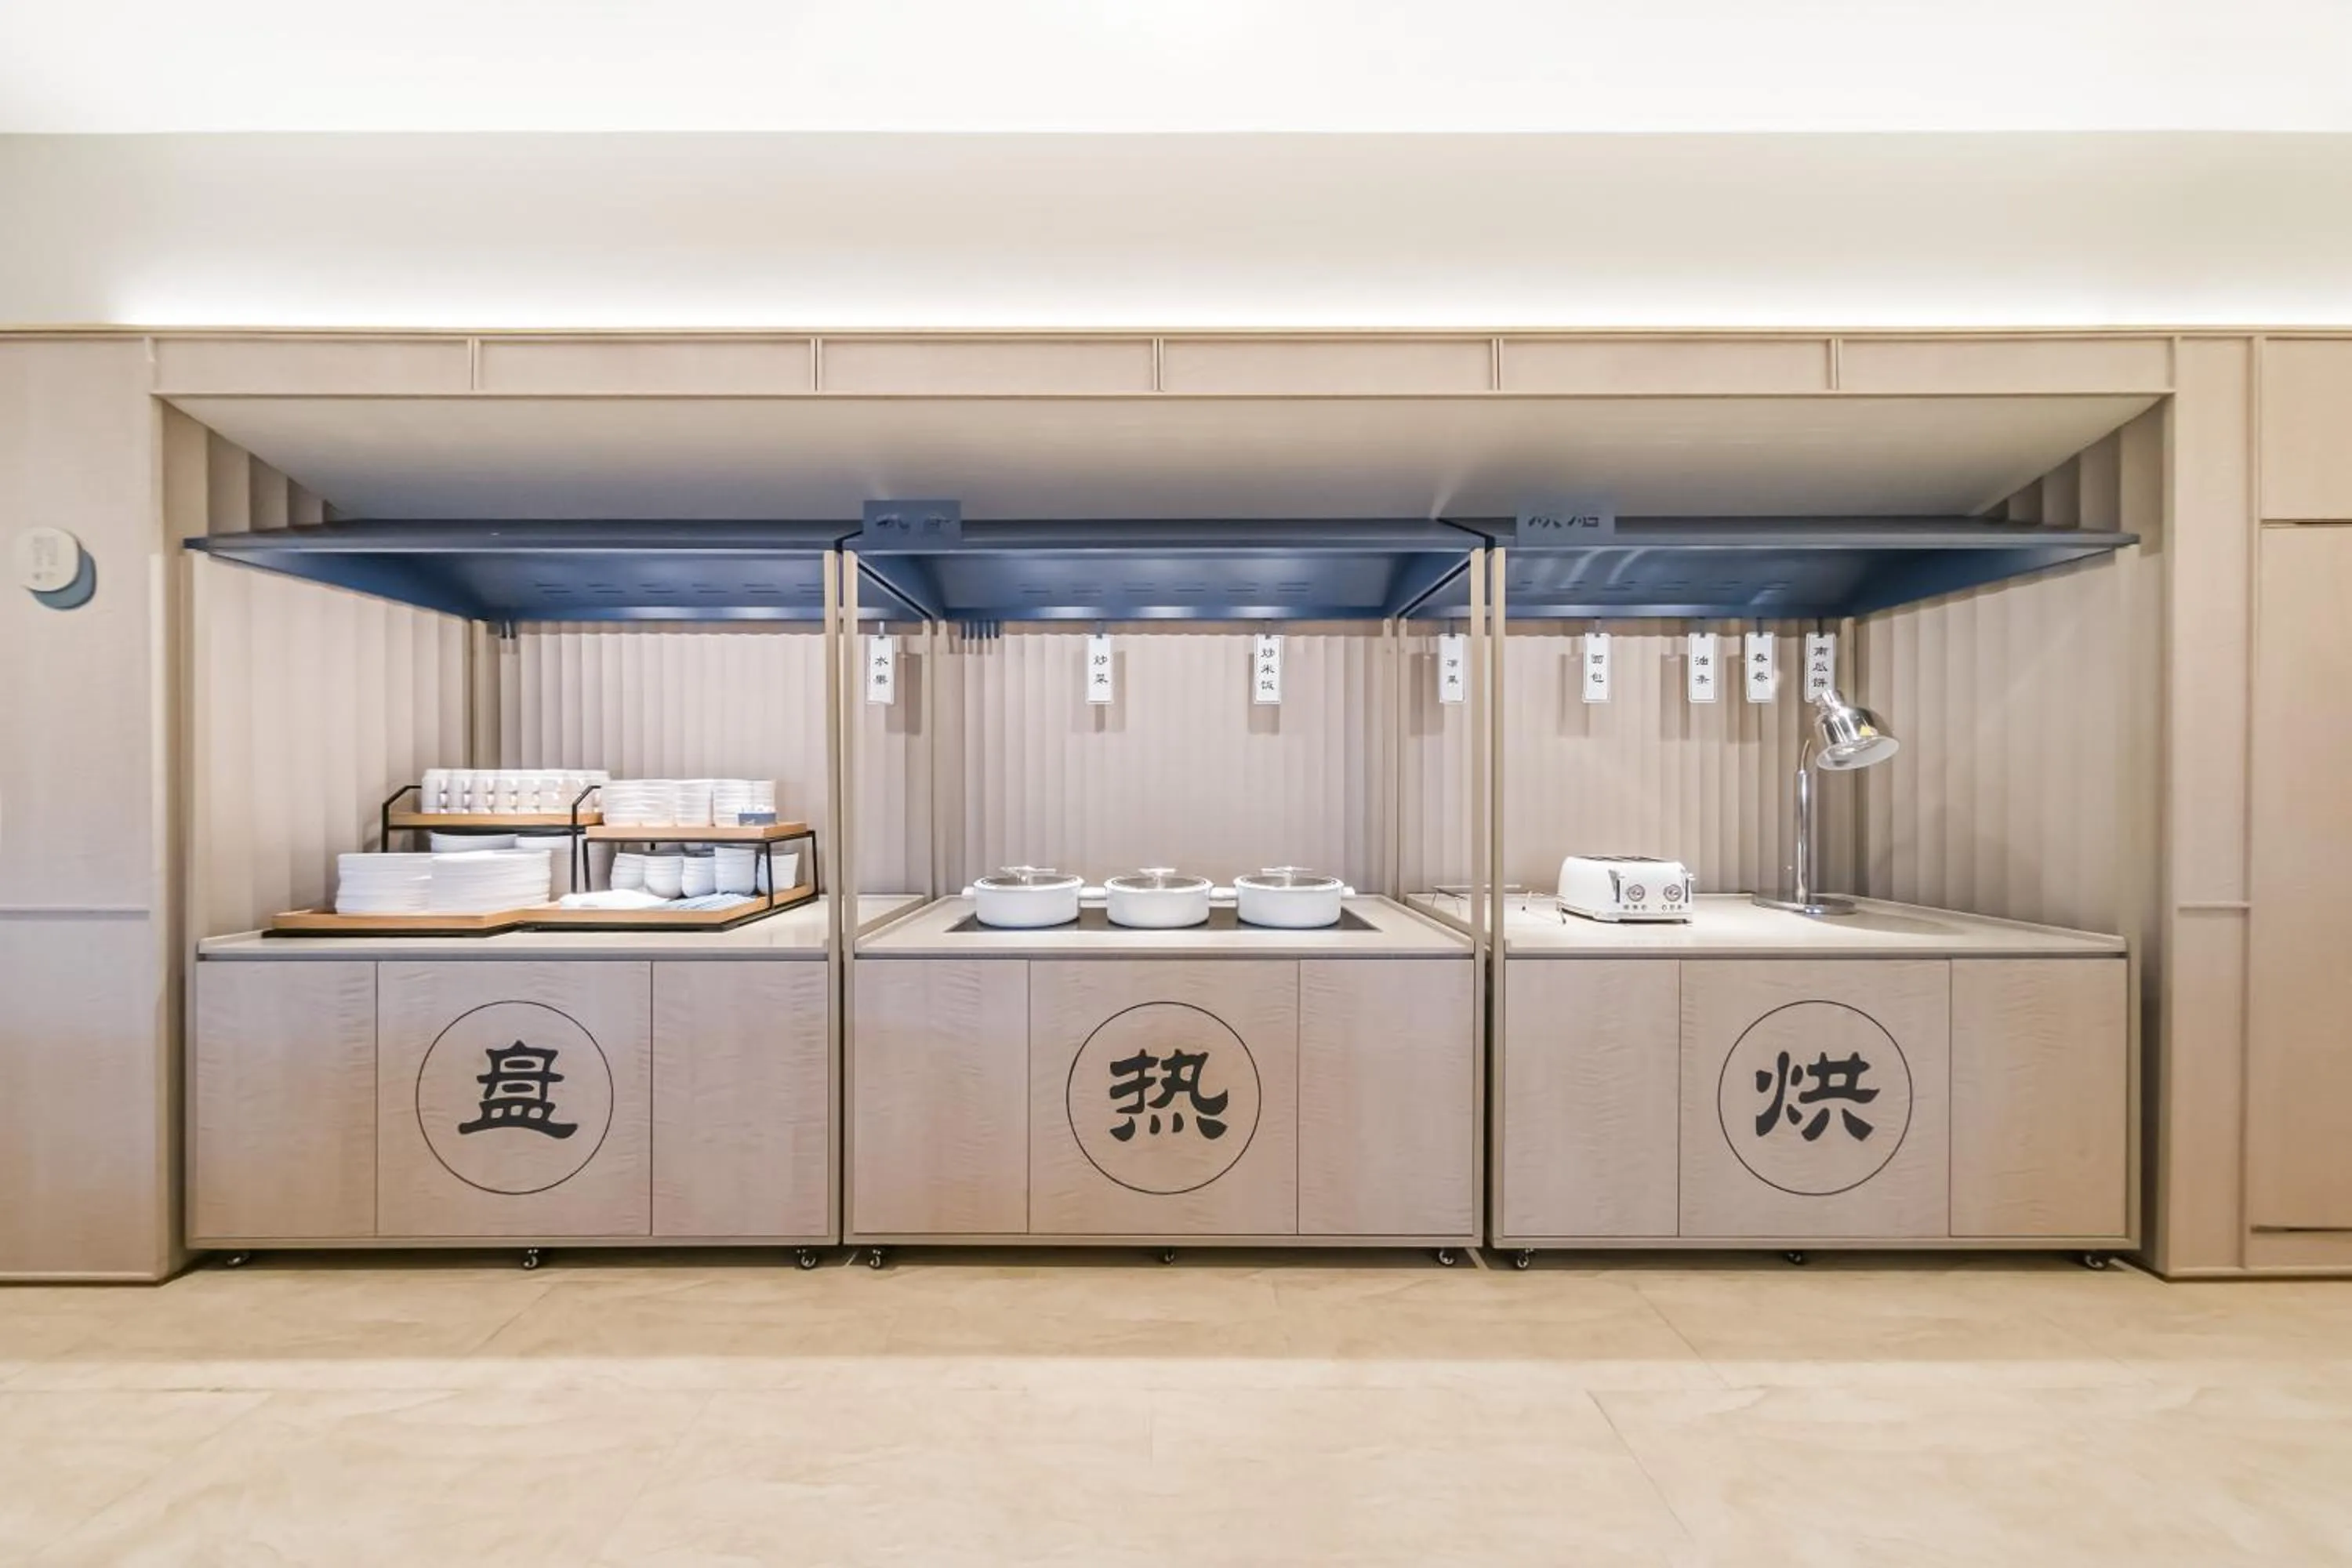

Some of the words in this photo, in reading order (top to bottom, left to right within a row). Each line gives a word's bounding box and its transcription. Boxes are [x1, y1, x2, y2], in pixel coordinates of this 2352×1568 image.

[1094, 655, 1109, 684] 炒菜
[1591, 654, 1605, 684] 面包
[1694, 655, 1710, 684] 油条
[1753, 652, 1769, 682] 春卷
[1813, 645, 1828, 688] 南瓜饼
[1109, 1048, 1229, 1142] 热
[1755, 1051, 1880, 1142] 烘
